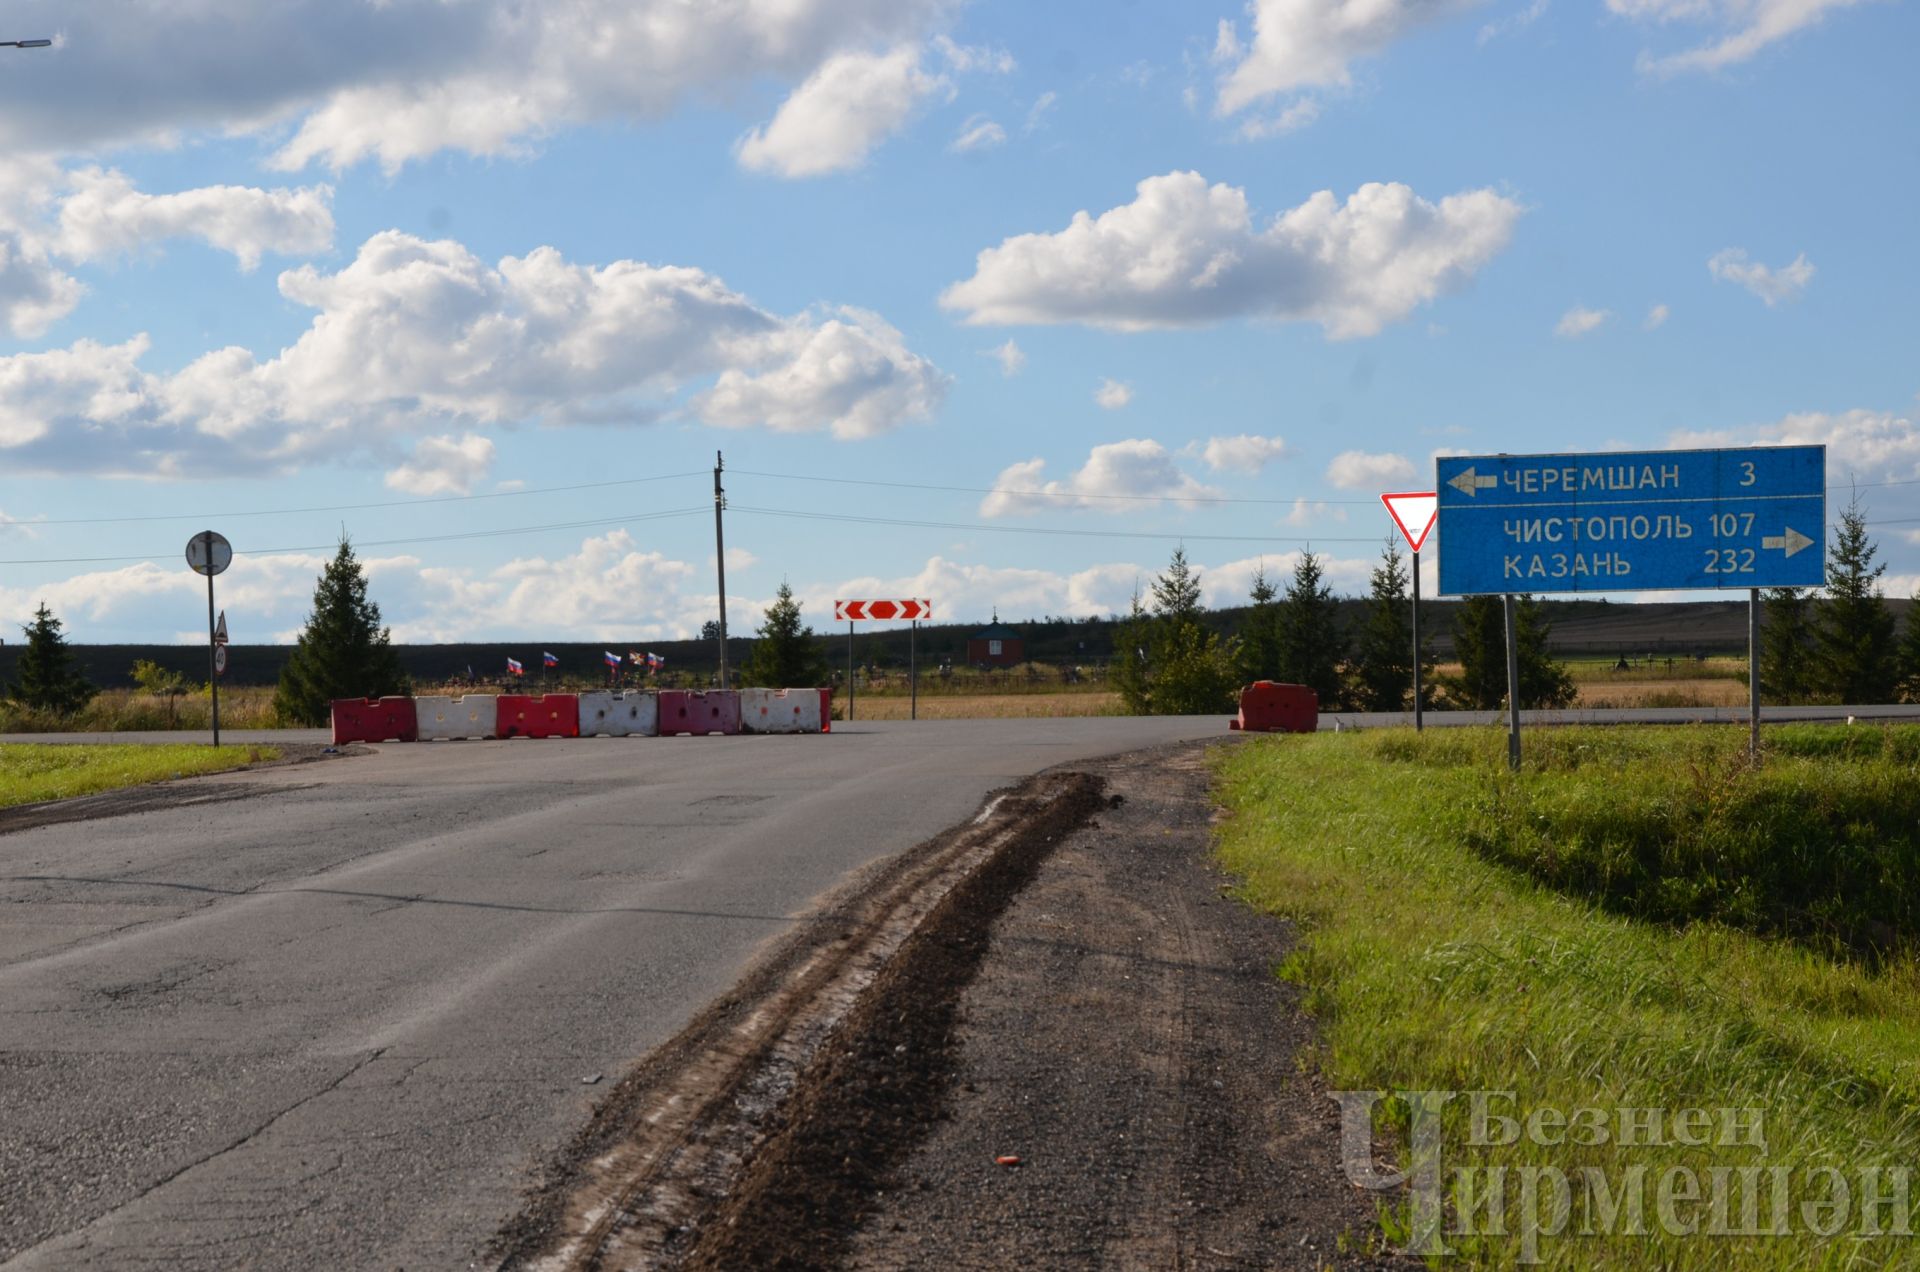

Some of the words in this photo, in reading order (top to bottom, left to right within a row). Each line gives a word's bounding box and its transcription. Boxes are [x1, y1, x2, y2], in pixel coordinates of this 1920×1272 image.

[1503, 465, 1680, 493] ЧЕРЕМШАН
[1739, 461, 1756, 487] 3
[1503, 515, 1693, 543] ЧИСТОПОЛЬ
[1708, 512, 1756, 538] 107
[1503, 551, 1631, 579] КАЗАНЬ
[1703, 548, 1756, 574] 232
